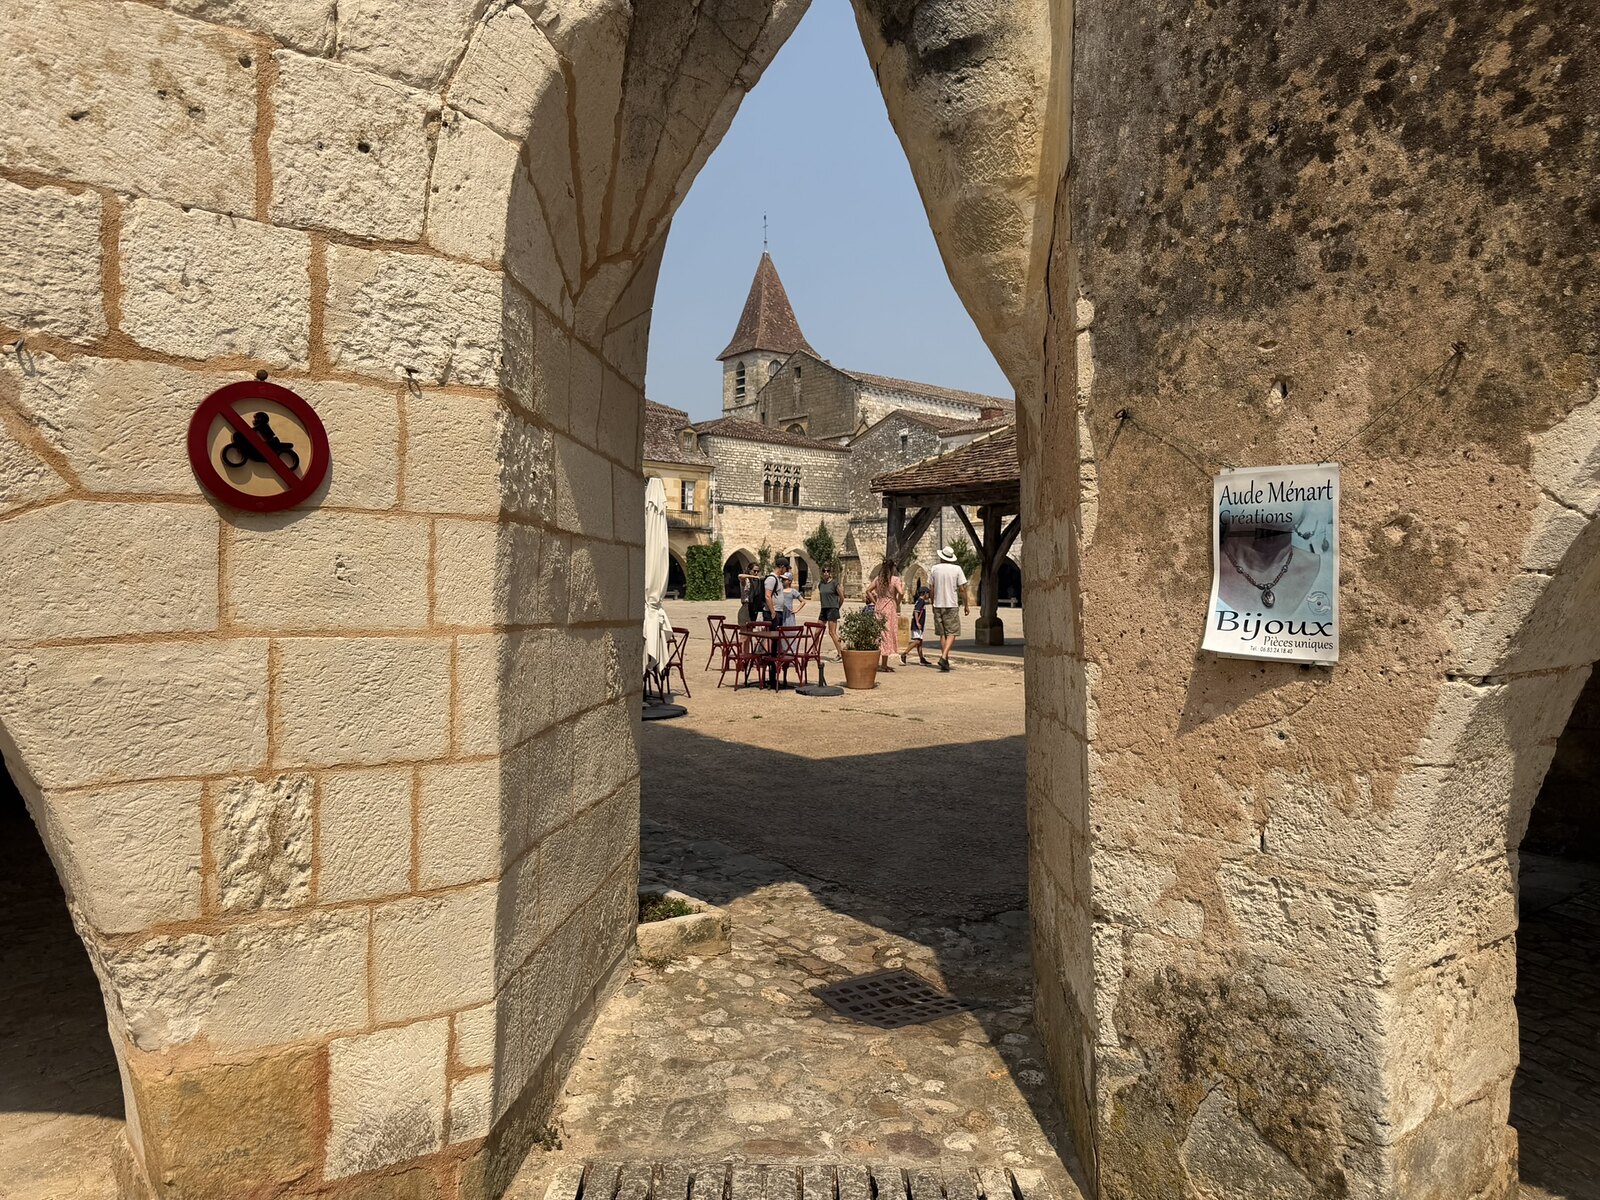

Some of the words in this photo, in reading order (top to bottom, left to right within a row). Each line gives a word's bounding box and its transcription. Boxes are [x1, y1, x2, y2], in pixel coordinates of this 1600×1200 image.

[1219, 480, 1263, 506] Aude
[1267, 479, 1333, 503] Ménart
[1219, 508, 1293, 525] Créations
[1216, 610, 1333, 641] Bijoux
[1263, 635, 1293, 648] Pièces
[1294, 638, 1334, 652] uniques
